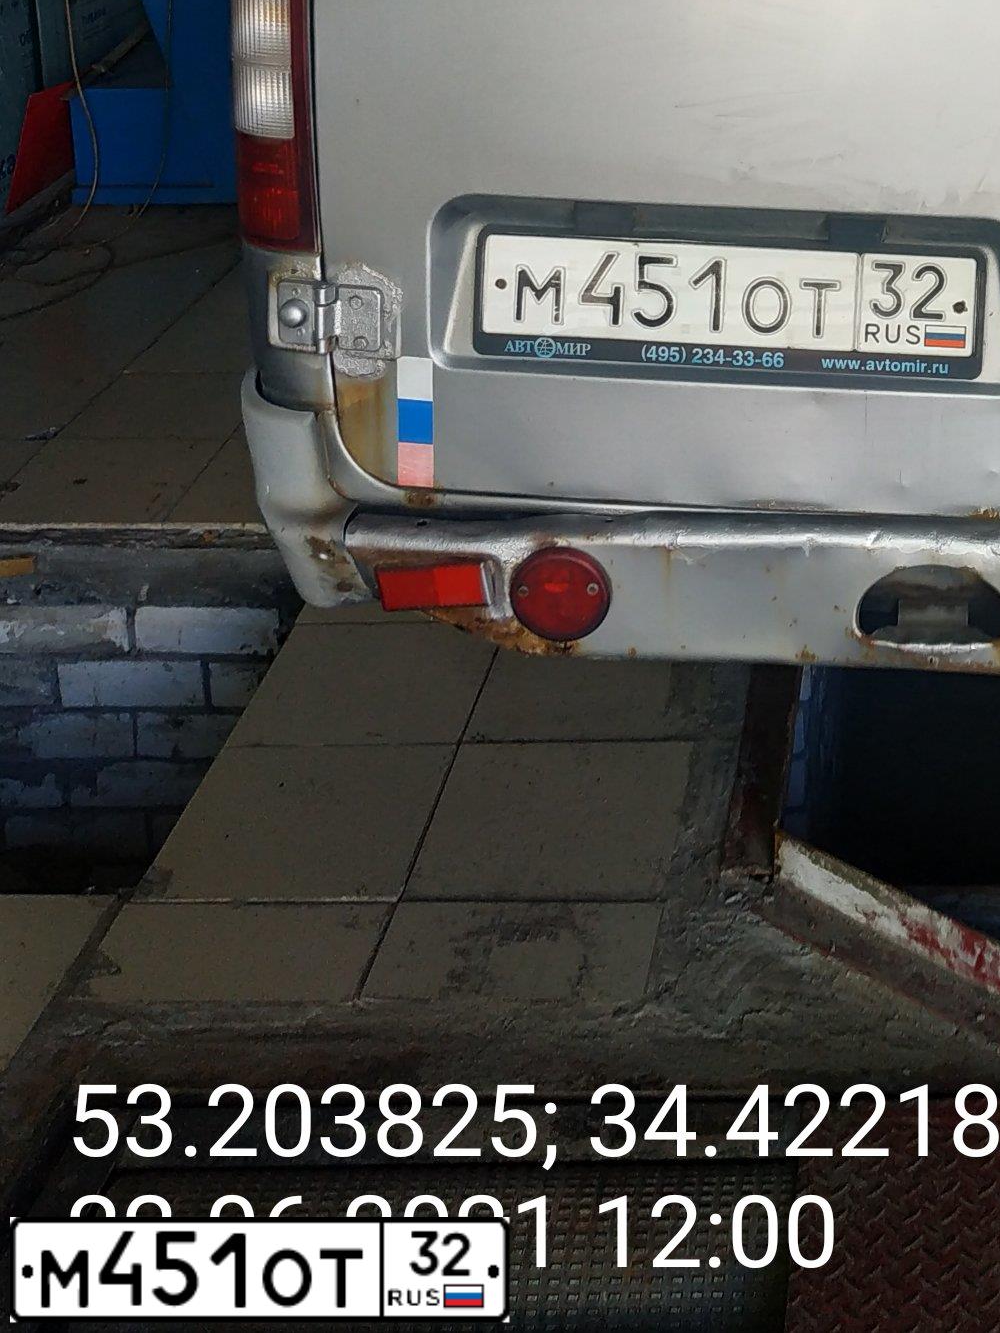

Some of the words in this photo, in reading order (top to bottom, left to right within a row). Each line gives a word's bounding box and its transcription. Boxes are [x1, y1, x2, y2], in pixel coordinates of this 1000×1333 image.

[869, 261, 944, 321] 32
[864, 323, 922, 345] RUS
[640, 344, 687, 365] (495)
[691, 346, 785, 369] 234-33-66
[821, 356, 949, 375] www.avtomir.ru
